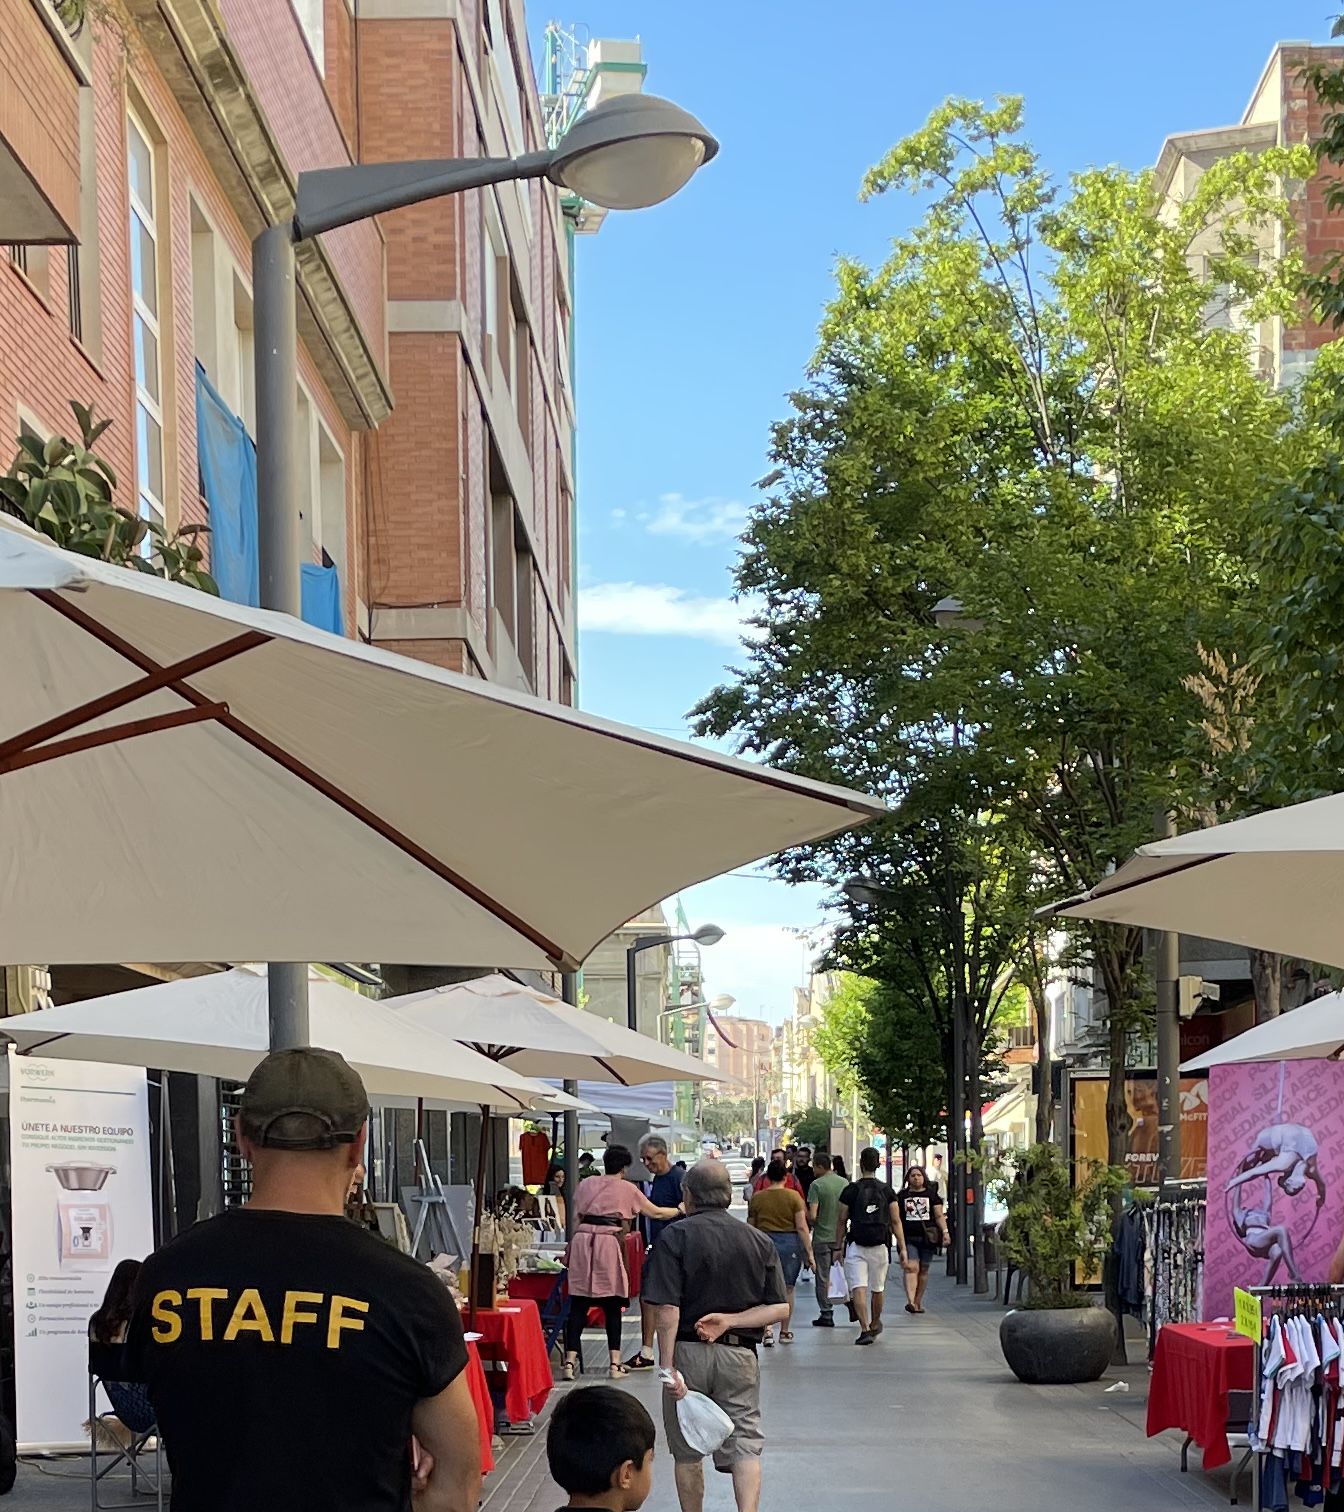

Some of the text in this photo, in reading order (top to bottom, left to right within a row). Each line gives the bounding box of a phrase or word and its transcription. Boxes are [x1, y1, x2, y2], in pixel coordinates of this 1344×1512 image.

[51, 1122, 59, 1133] A
[60, 1123, 101, 1135] NUESTRO
[102, 1126, 134, 1137] EQUIPO
[151, 1287, 370, 1349] STAFF
